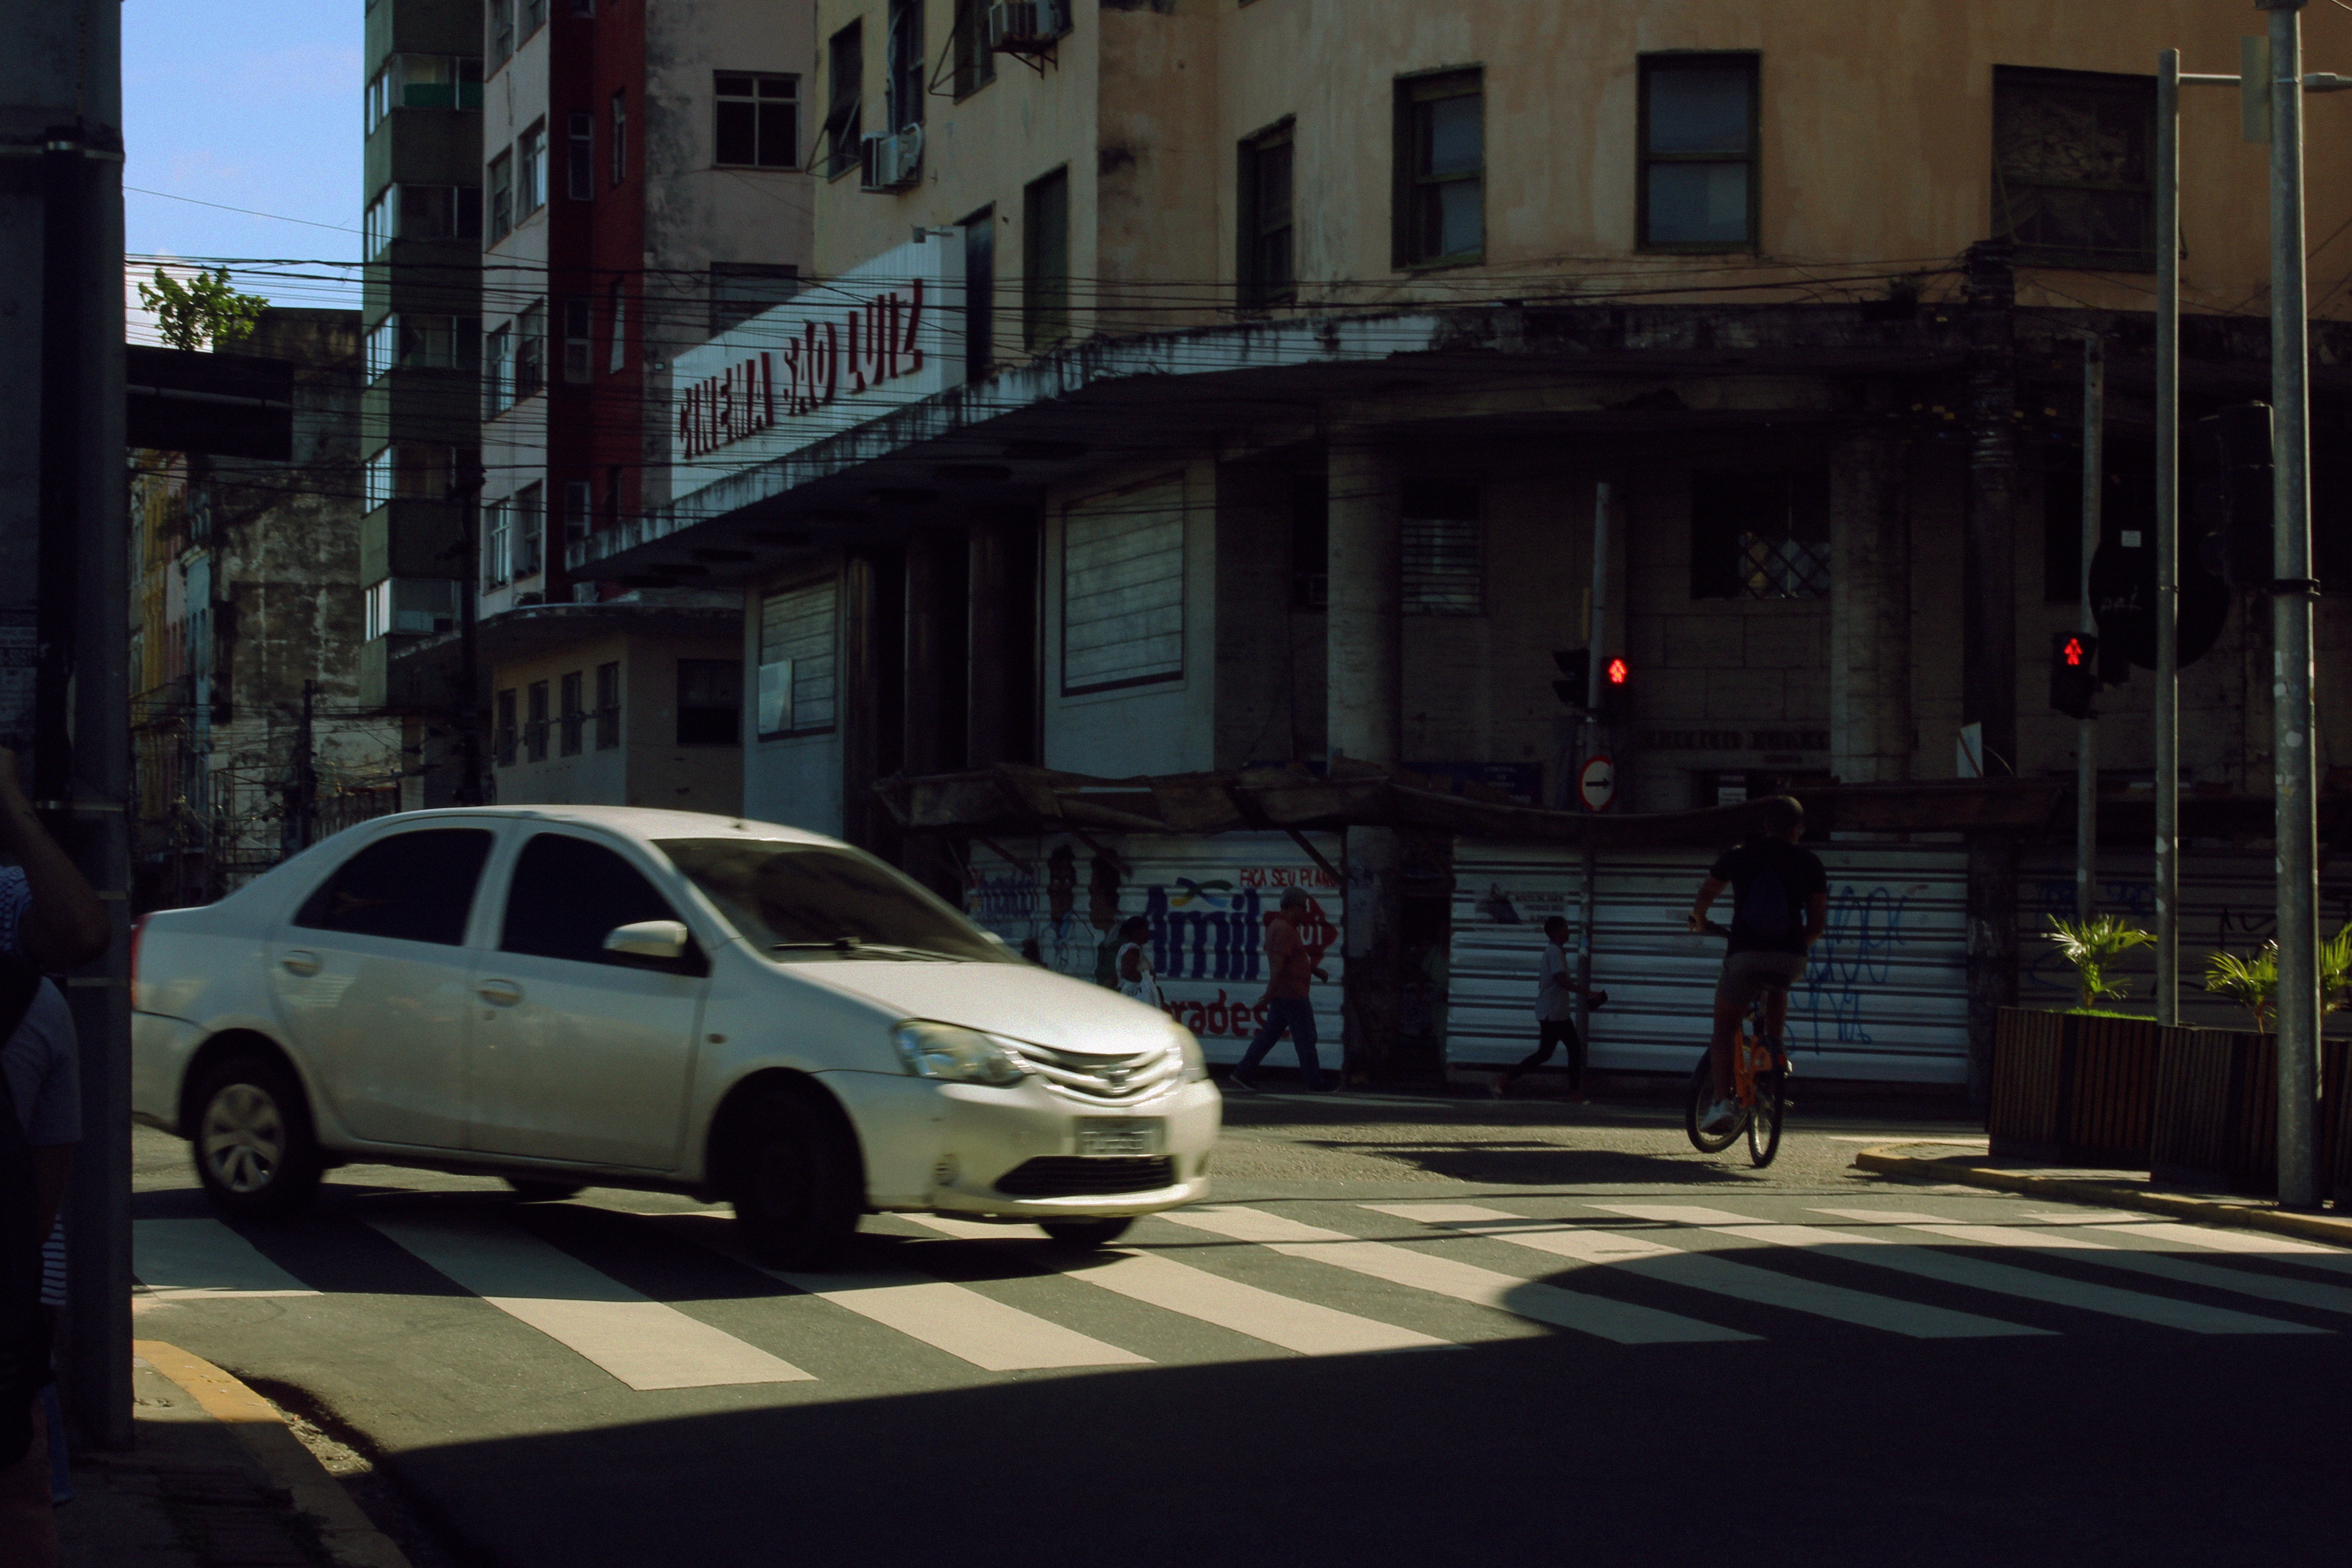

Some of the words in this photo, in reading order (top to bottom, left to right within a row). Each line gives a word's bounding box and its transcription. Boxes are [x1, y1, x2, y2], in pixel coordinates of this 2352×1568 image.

[680, 352, 774, 459] CINEMA
[846, 278, 923, 394] LUIZ
[1271, 867, 1296, 887] SEU
